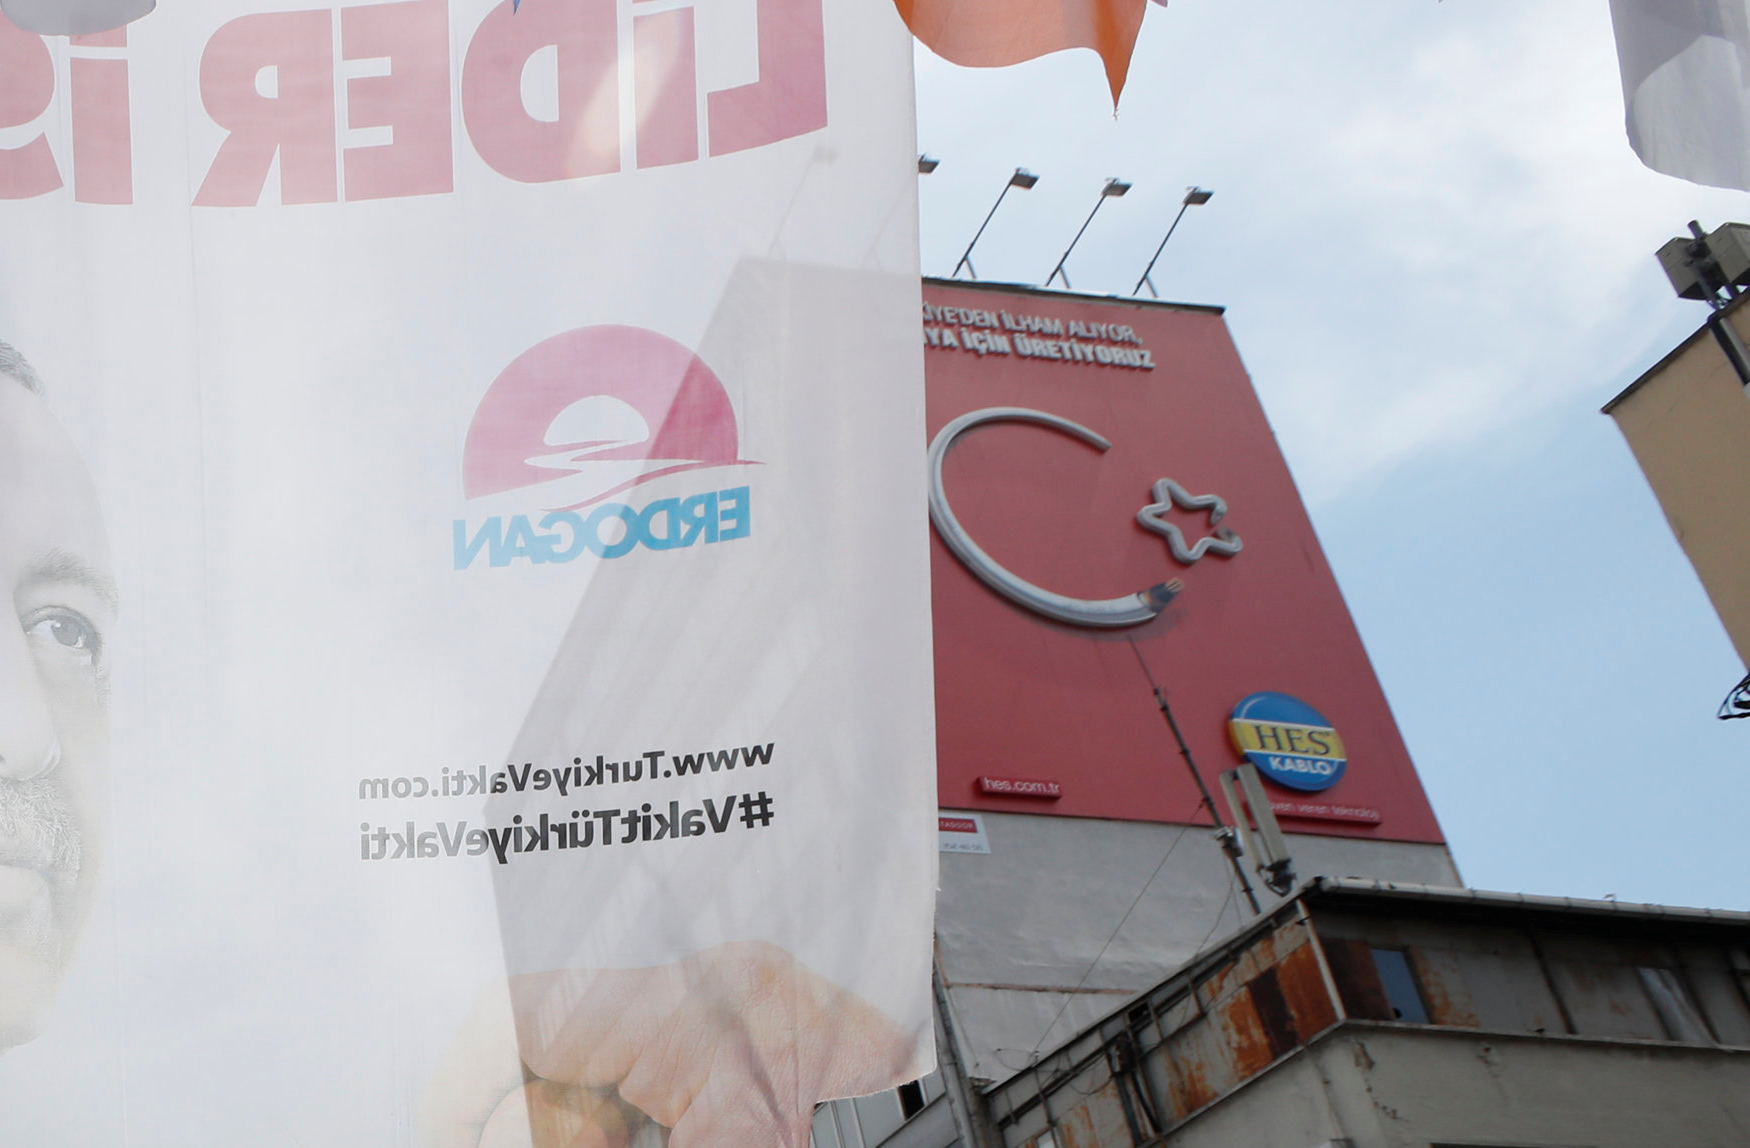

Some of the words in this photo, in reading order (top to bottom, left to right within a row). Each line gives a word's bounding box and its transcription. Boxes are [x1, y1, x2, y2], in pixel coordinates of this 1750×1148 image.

[1000, 309, 1064, 338] İLHAM
[961, 326, 1012, 356] İÇİN
[1013, 333, 1157, 370] ÜRETİYORUZ
[1254, 724, 1330, 756] HES
[1268, 755, 1332, 776] KABLO
[983, 776, 1060, 796] hes.com.tr
